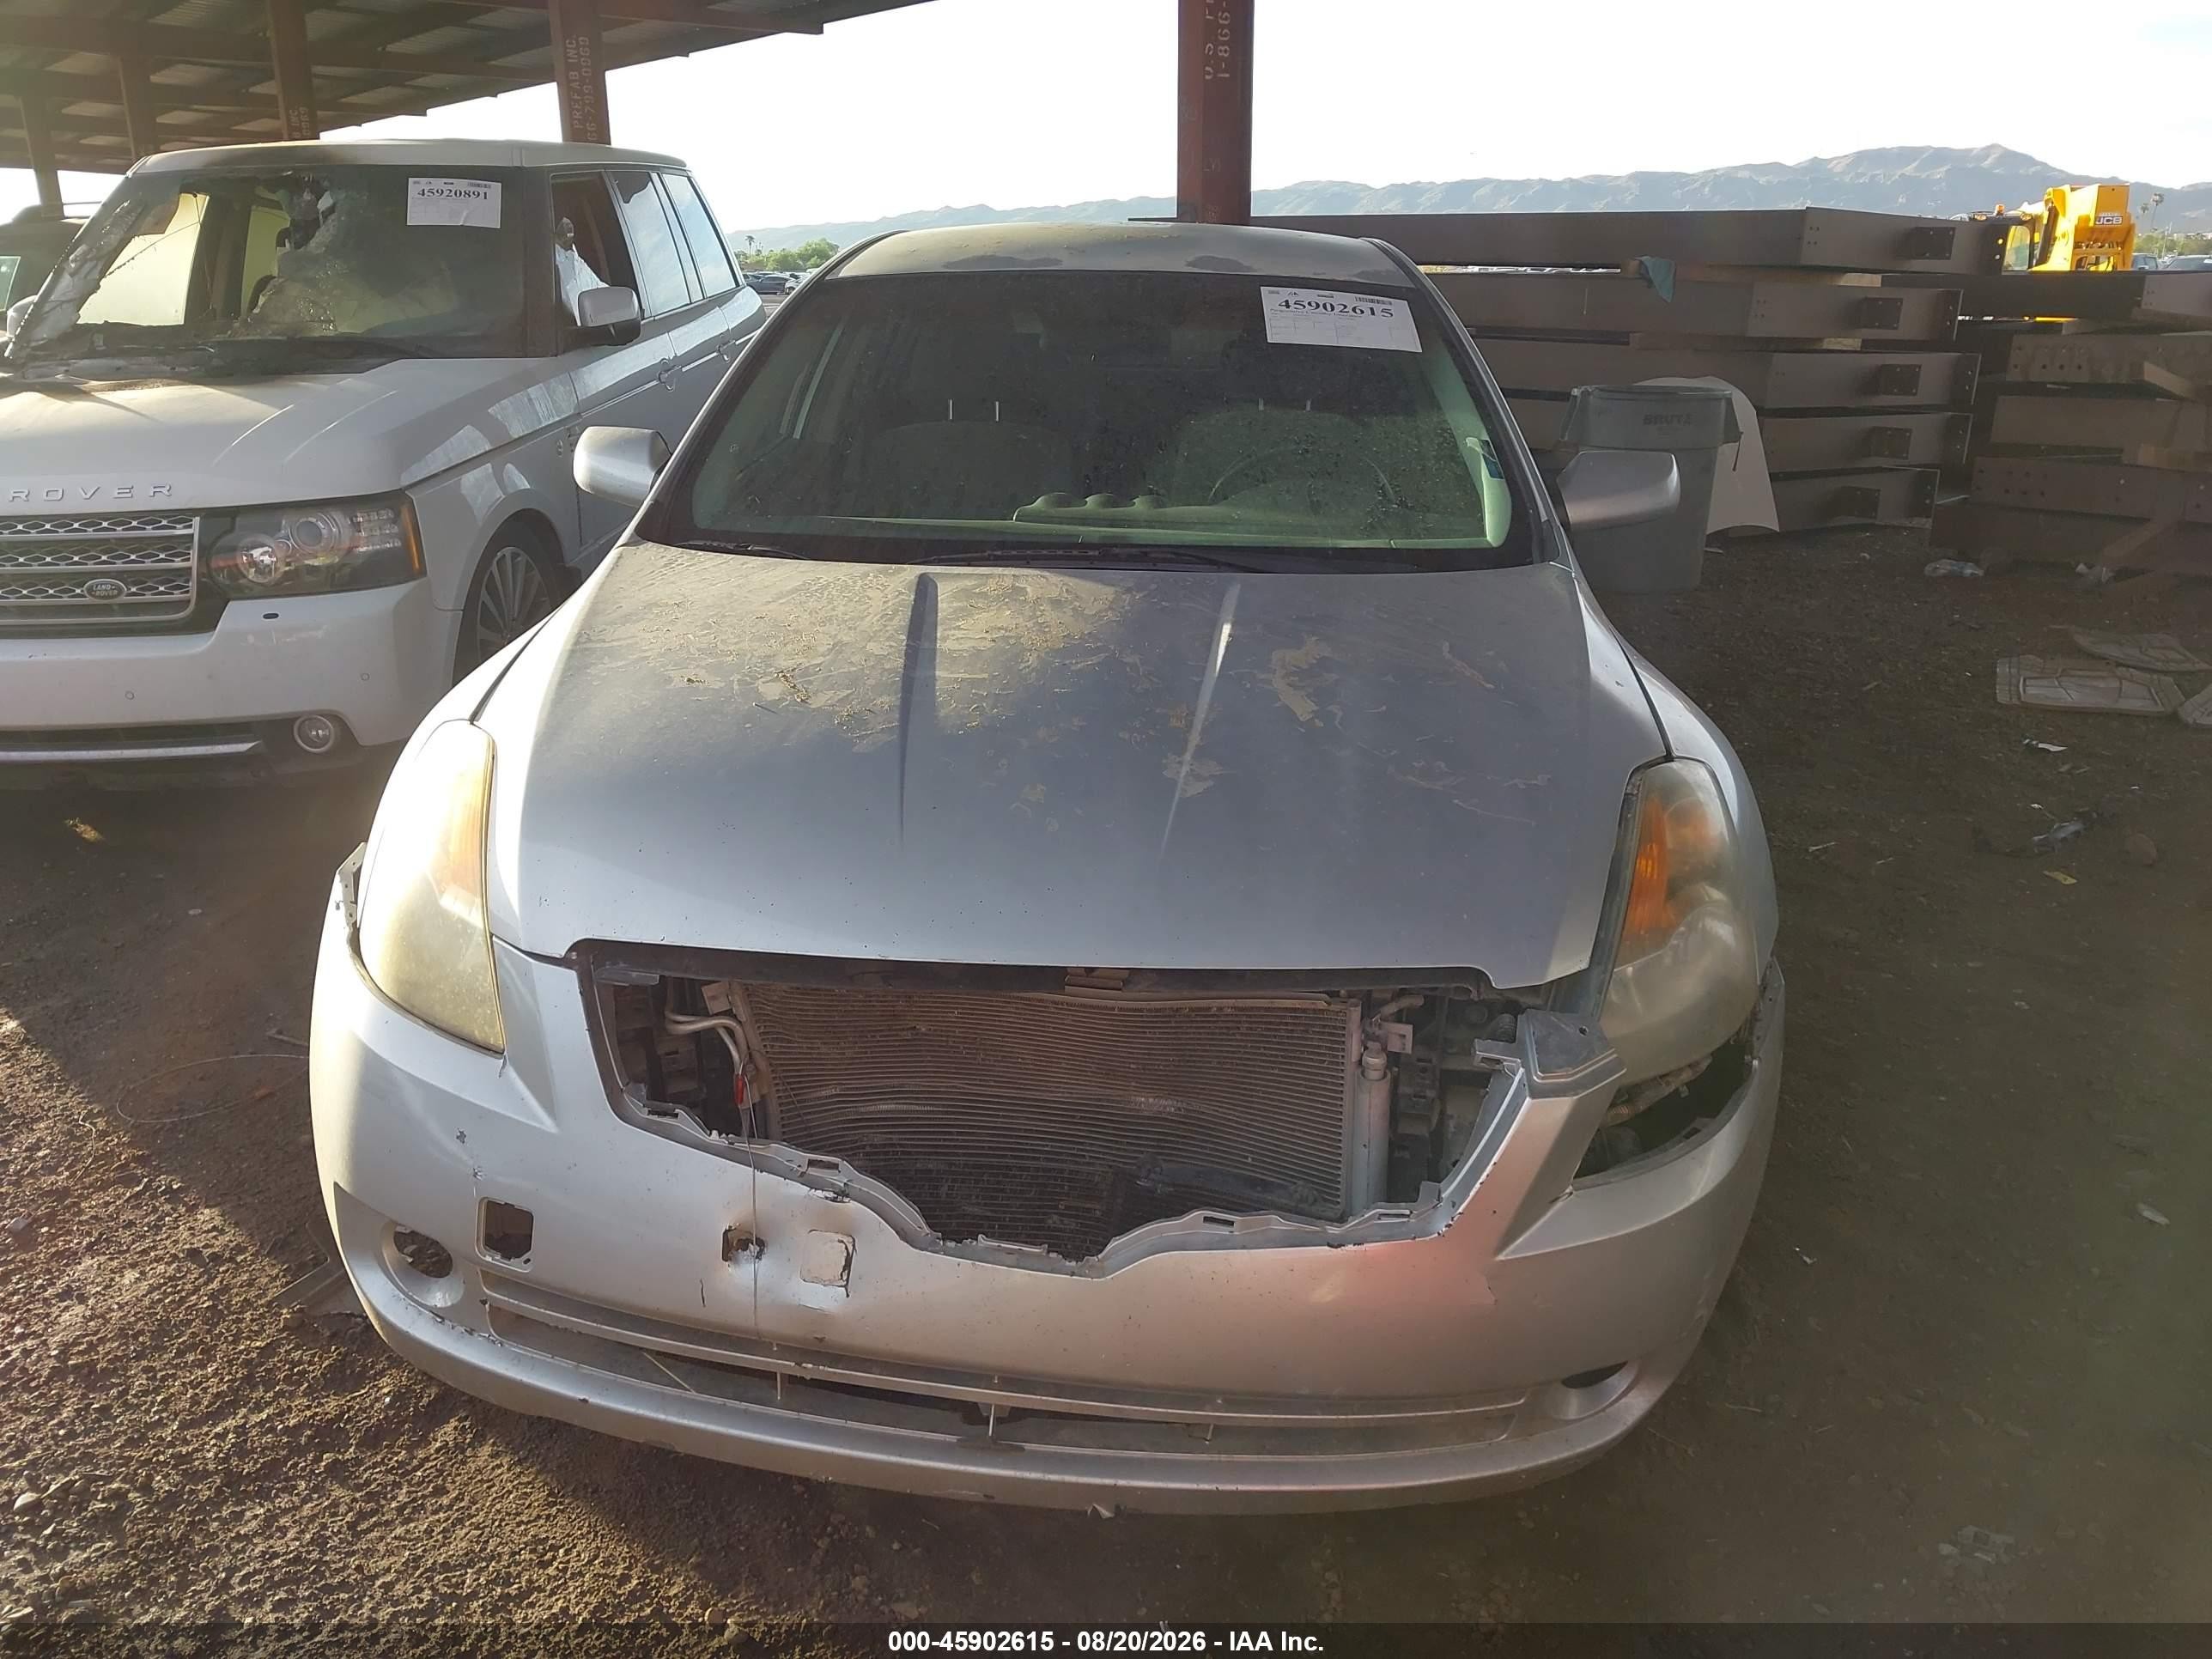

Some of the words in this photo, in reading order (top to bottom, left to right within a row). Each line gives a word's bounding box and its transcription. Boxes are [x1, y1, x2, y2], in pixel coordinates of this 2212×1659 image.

[566, 34, 579, 62] INC.
[568, 70, 584, 129] PREFAB
[417, 188, 489, 200] 45920891
[2095, 216, 2123, 225] JCB
[1278, 299, 1395, 319] 45902615
[9, 483, 172, 501] ROVER
